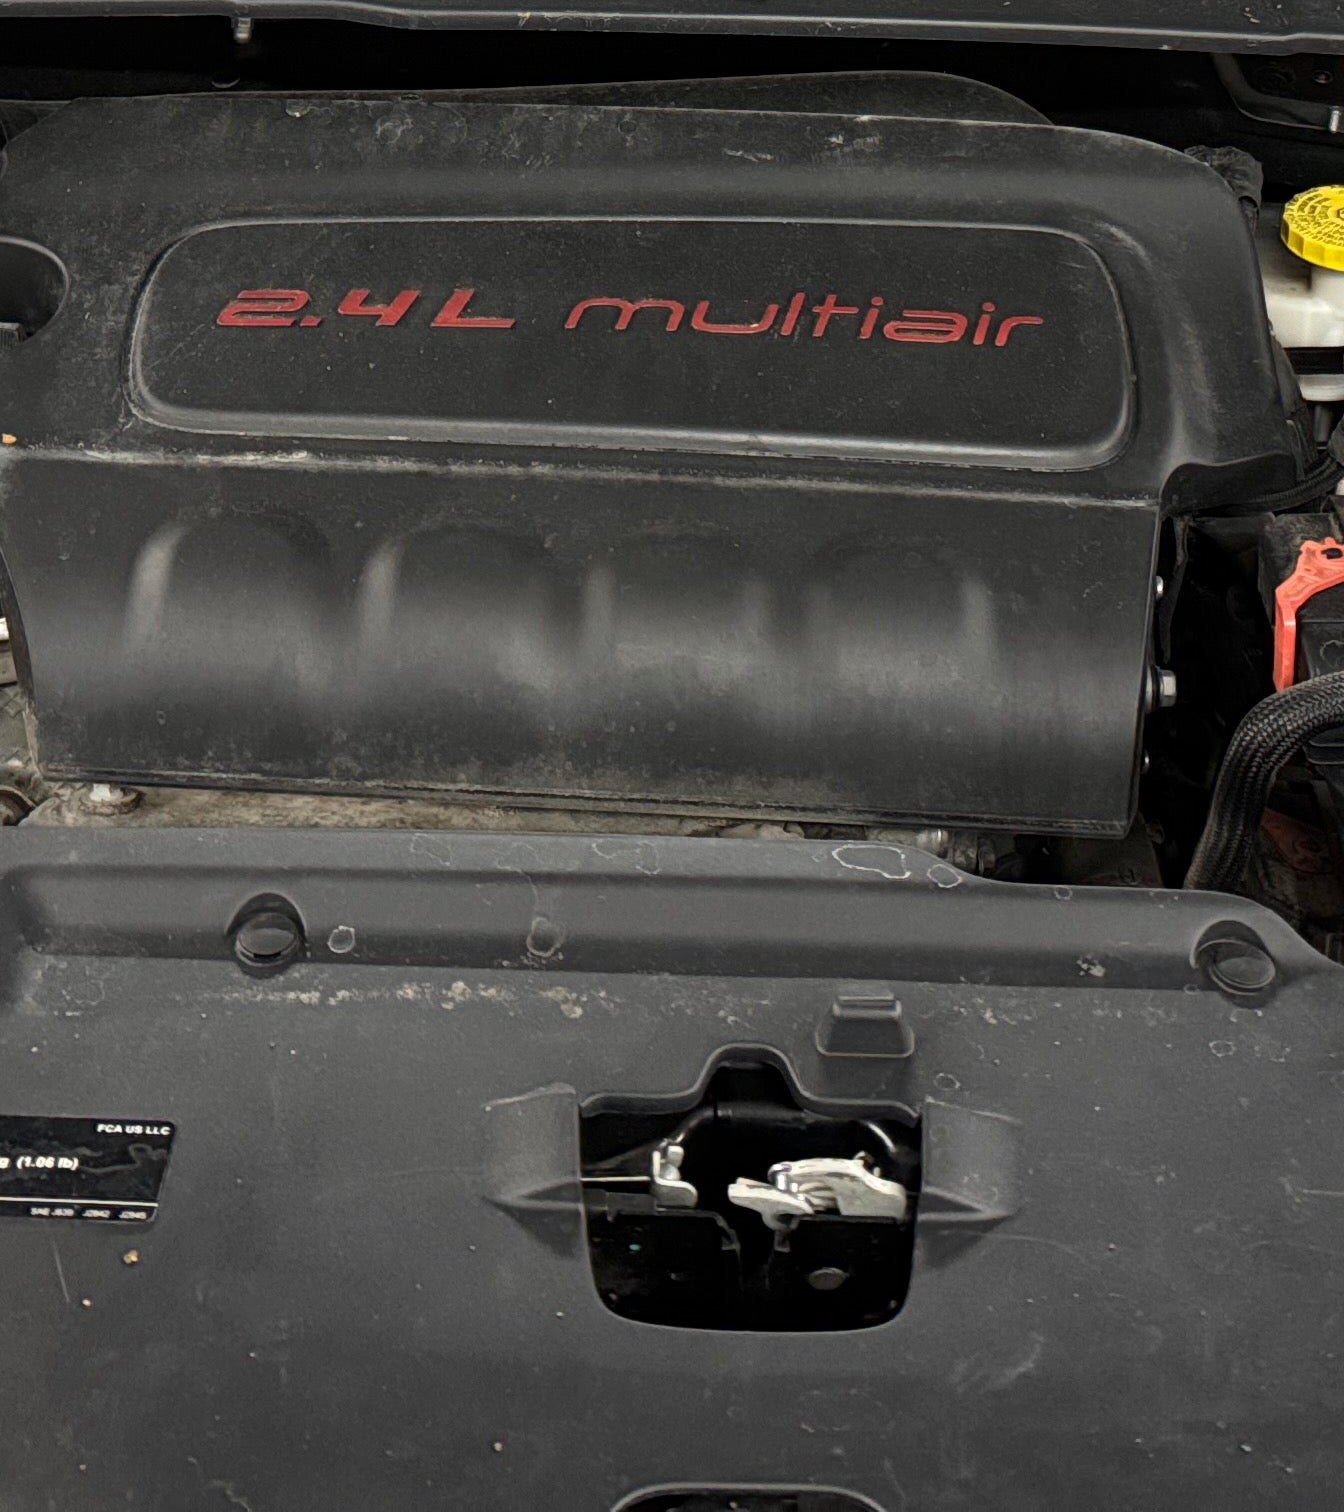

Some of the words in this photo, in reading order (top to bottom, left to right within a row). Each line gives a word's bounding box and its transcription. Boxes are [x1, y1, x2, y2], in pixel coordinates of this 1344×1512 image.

[565, 291, 1045, 348] multiair
[96, 1123, 123, 1135] FCA
[125, 1124, 144, 1135] US
[145, 1125, 171, 1136] LLC
[16, 1155, 54, 1170] (1.06
[58, 1157, 80, 1171] lb)
